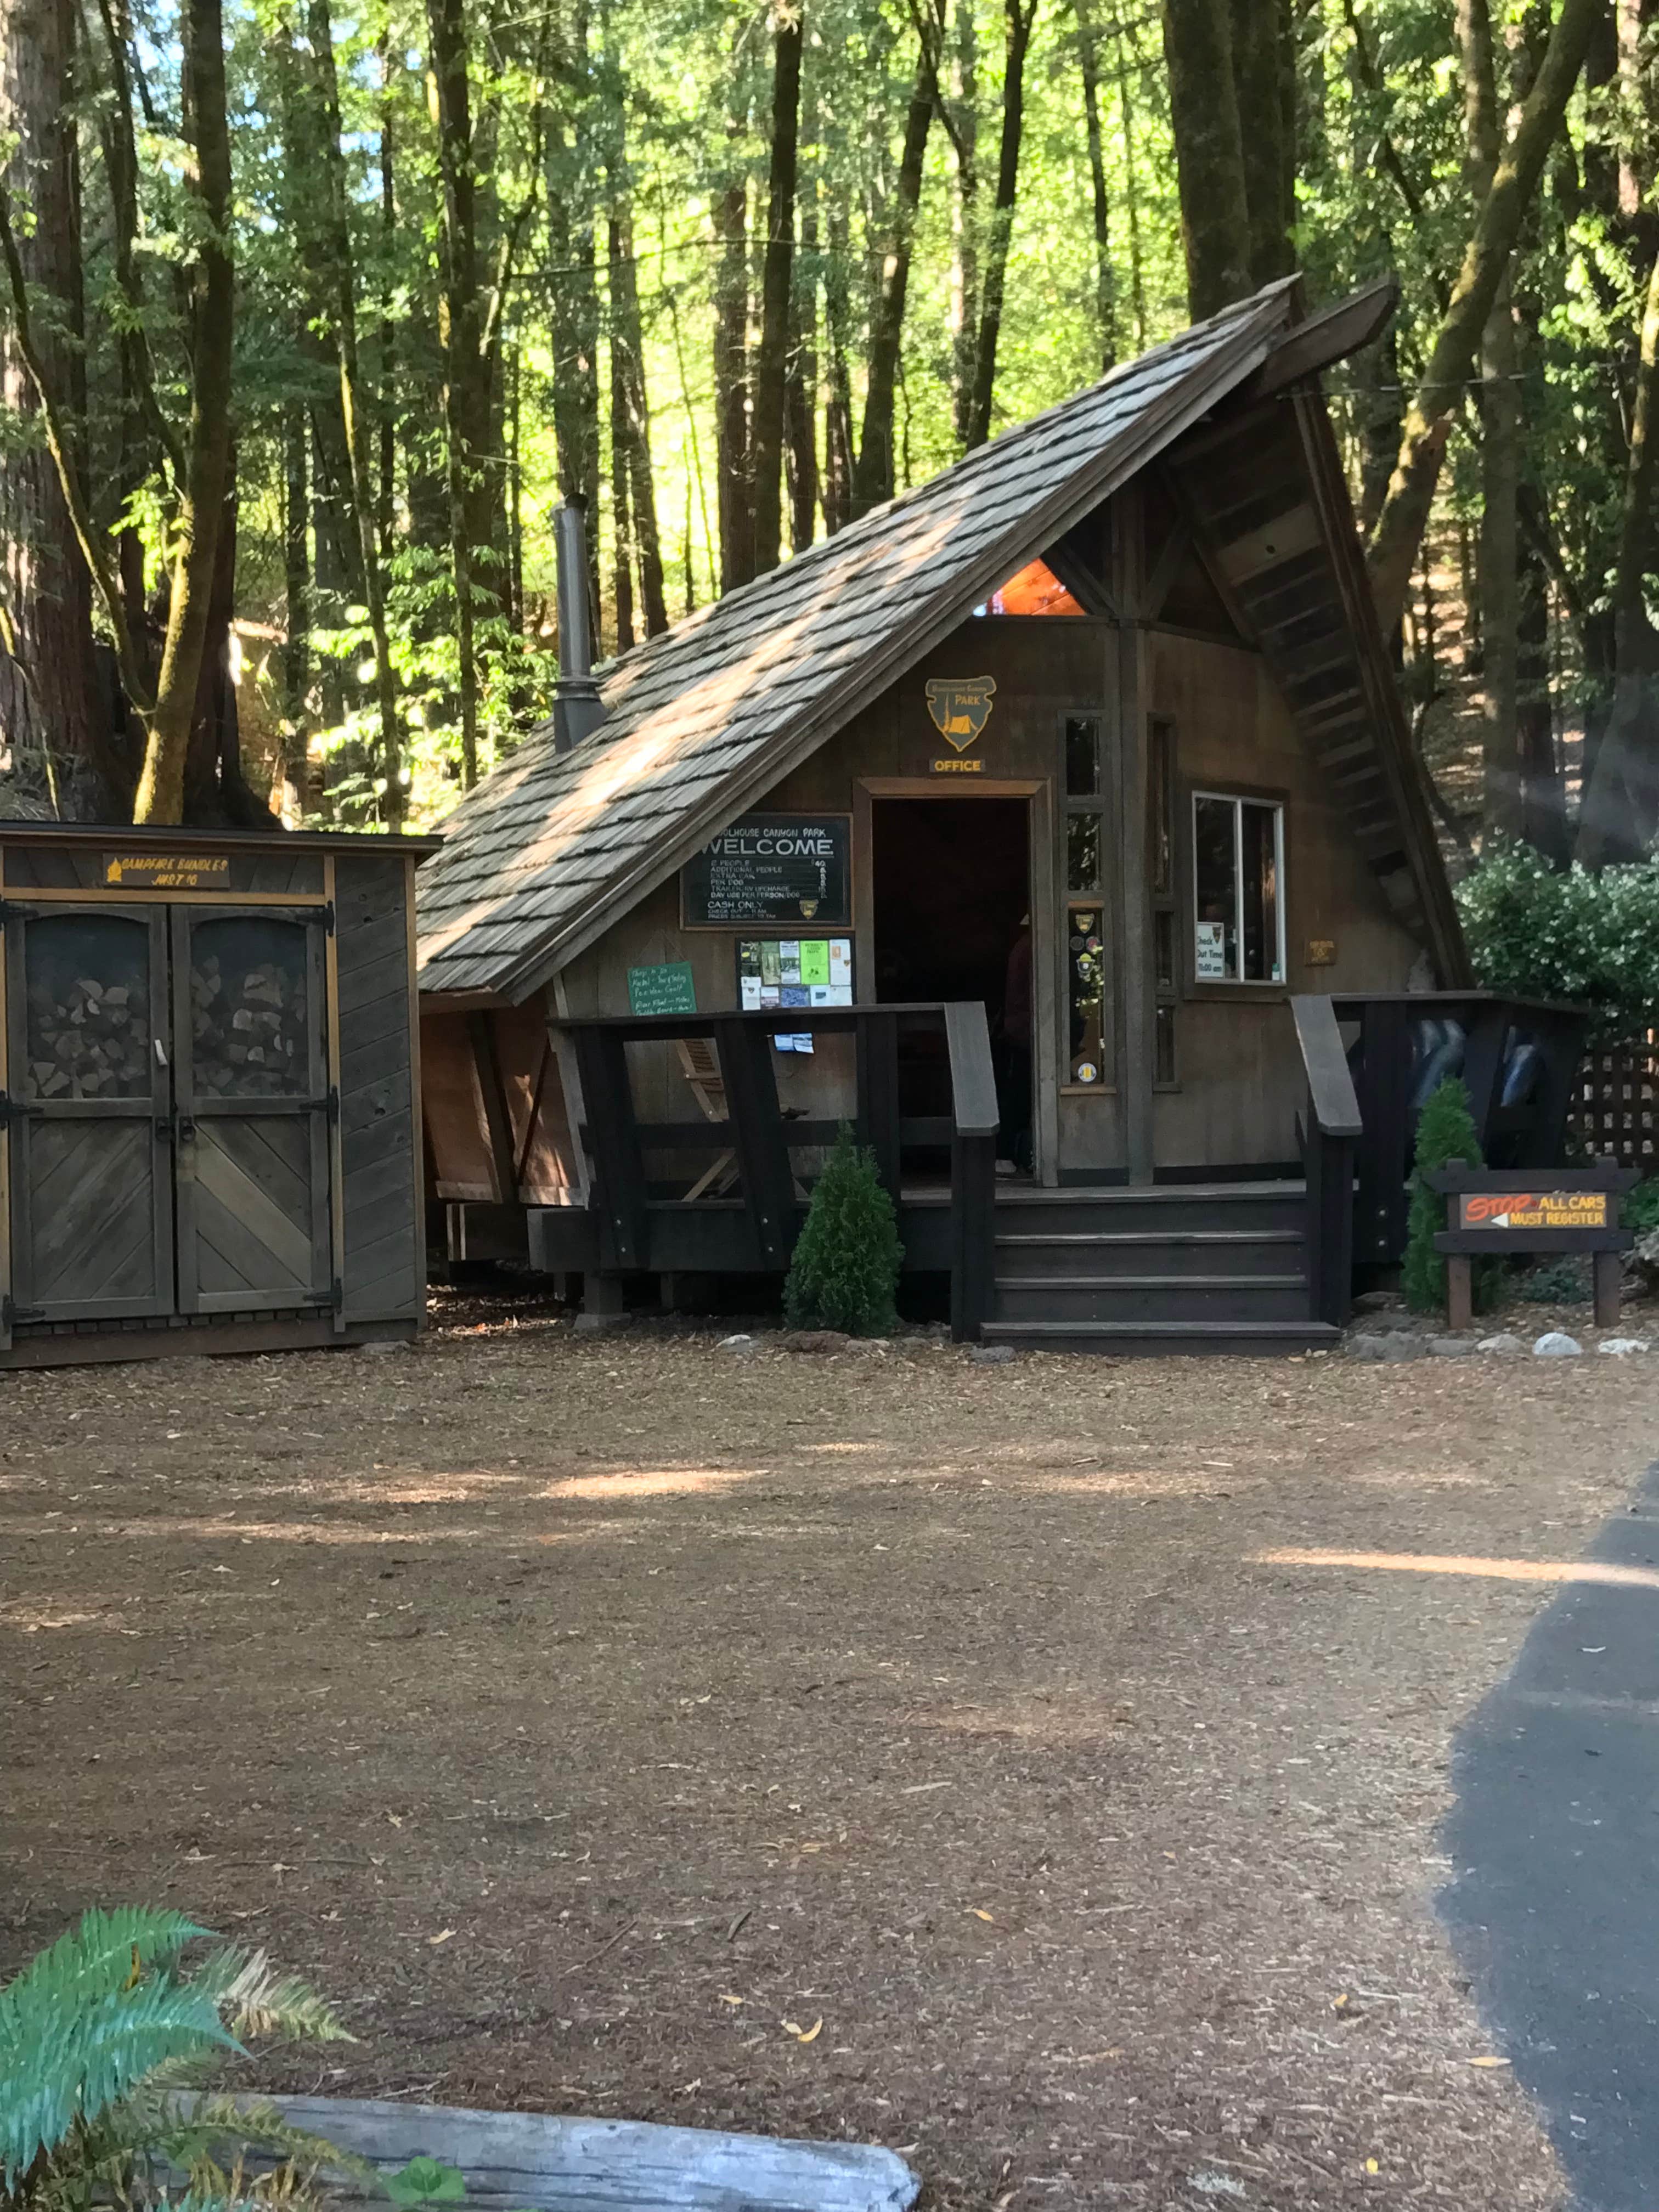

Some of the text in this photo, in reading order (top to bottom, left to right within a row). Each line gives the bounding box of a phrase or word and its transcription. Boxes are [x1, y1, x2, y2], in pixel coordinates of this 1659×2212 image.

[955, 693, 981, 706] PARK
[934, 760, 981, 772] OFFICE
[763, 828, 798, 837] CANYON
[803, 827, 826, 838] PARK
[121, 857, 229, 871] CAMPFIRE BUNDLES
[151, 873, 185, 886] JUST
[707, 900, 764, 909] CASH ONLY
[1209, 949, 1223, 958] Time
[1465, 1194, 1606, 1222] STOP ALL CARS
[1510, 1212, 1604, 1226] MUST REGISTER
